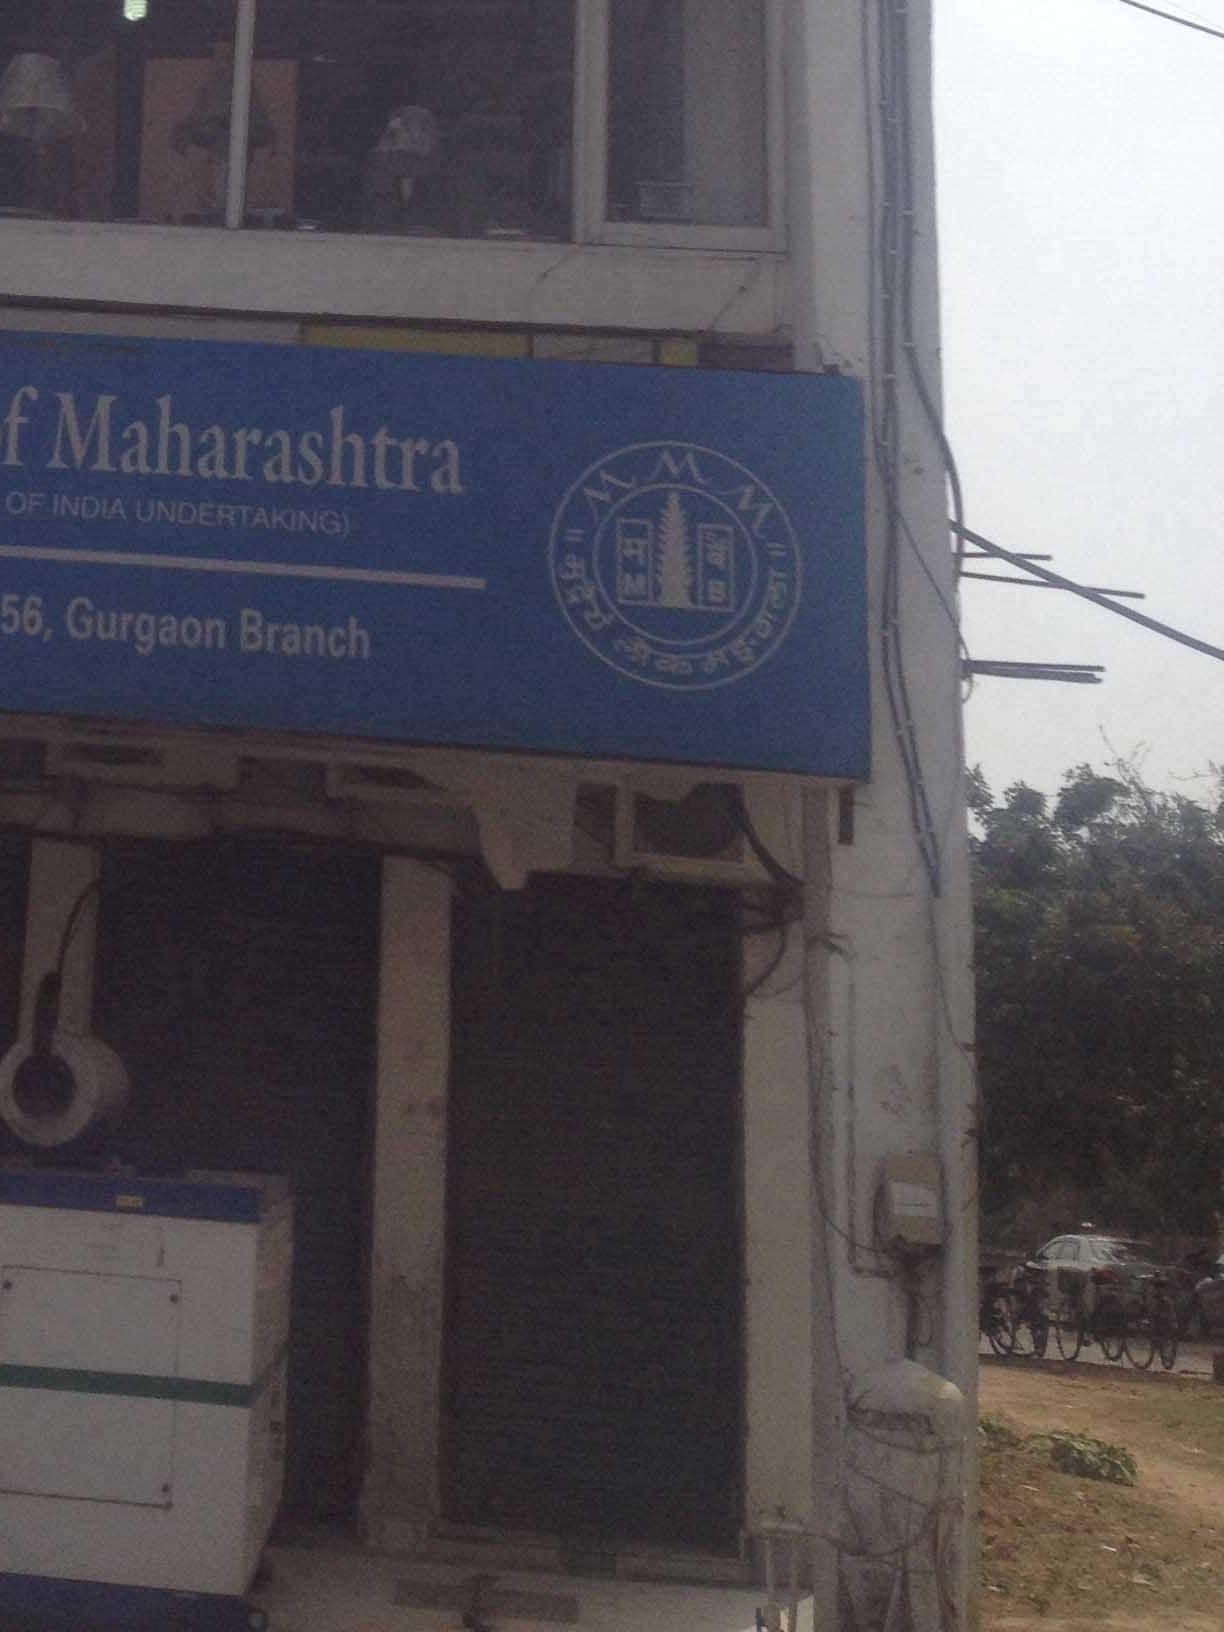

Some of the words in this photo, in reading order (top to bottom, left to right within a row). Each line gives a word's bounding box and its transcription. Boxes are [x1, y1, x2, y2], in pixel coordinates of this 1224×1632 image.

[45, 389, 465, 496] Maharashtra
[6, 491, 45, 516] OF
[52, 493, 127, 522] INDIA
[136, 500, 352, 537] UNDERTAKING)
[0, 593, 55, 642] 56,
[66, 596, 226, 657] Gurgaon
[239, 607, 372, 659] Branch
